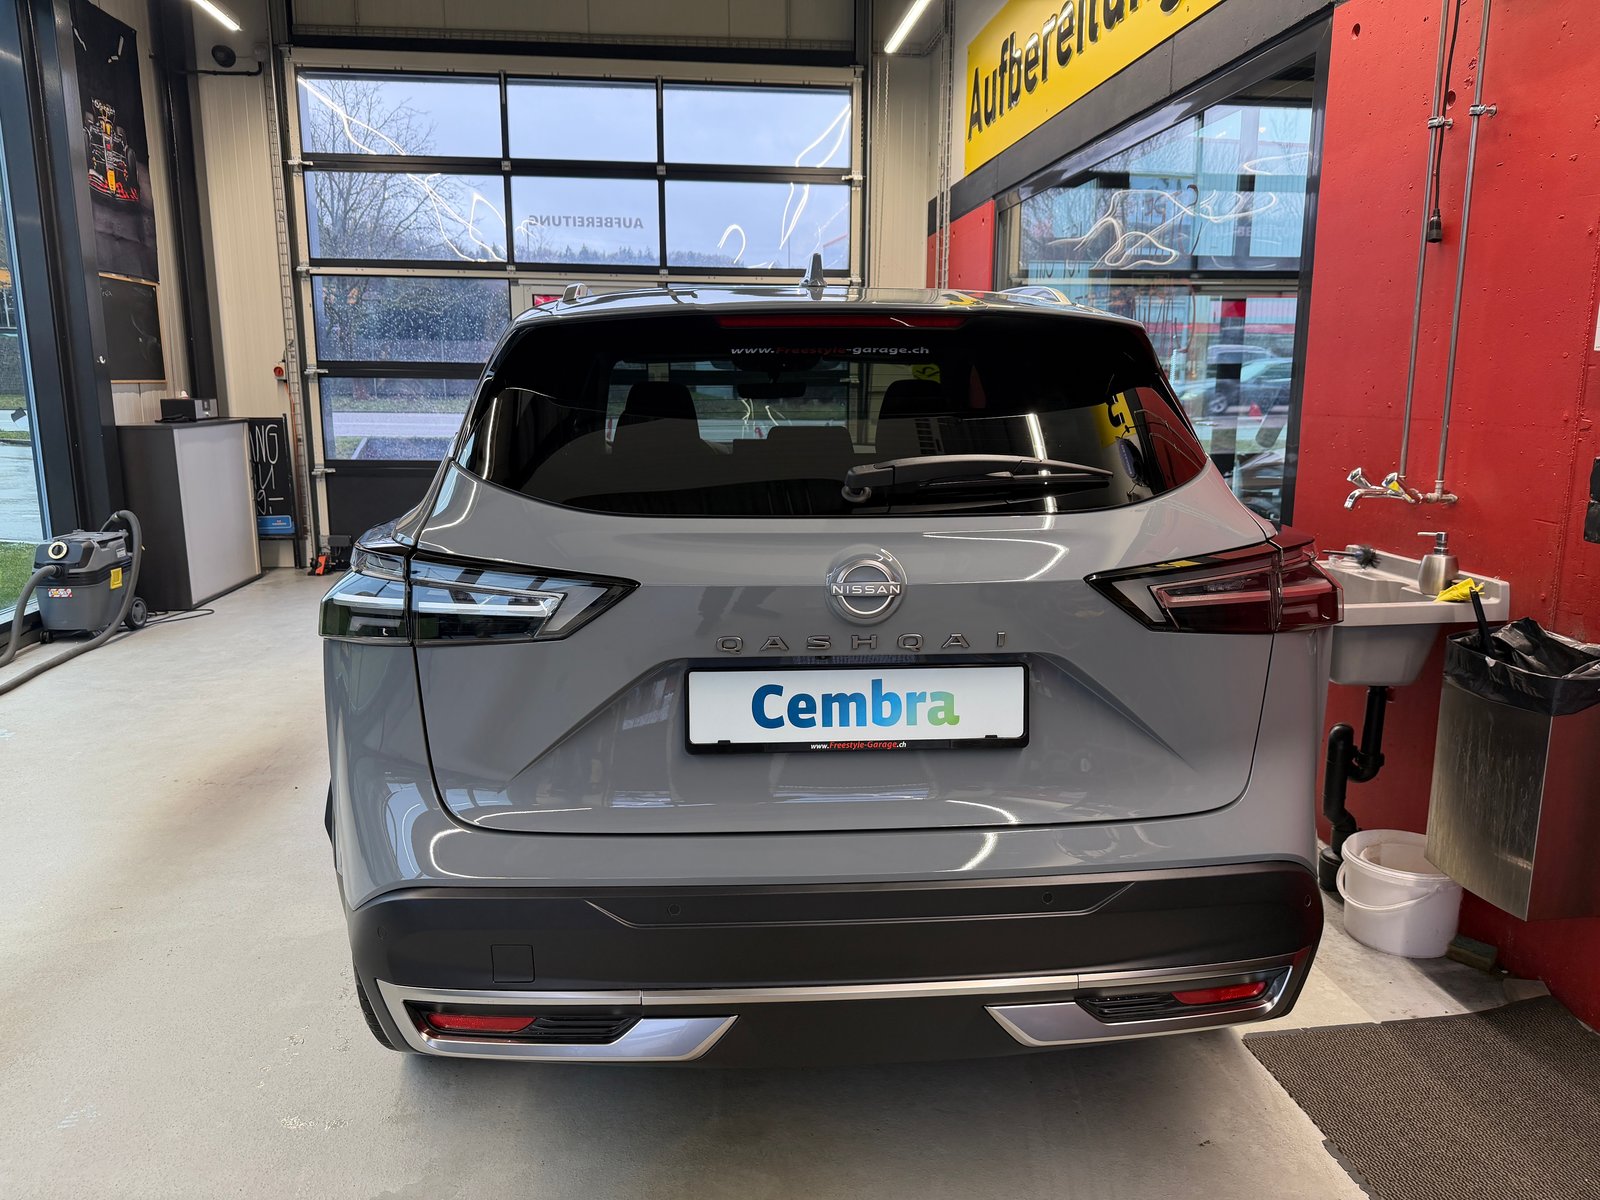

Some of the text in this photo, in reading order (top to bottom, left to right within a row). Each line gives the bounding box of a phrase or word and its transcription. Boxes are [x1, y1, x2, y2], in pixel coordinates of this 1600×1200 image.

[967, 0, 1181, 142] Aufbereit
[831, 583, 901, 595] NISSAN
[715, 631, 1008, 654] QASHQAI
[751, 678, 961, 730] Cembra
[810, 741, 907, 751] www.Freestyle-Garage.ch
